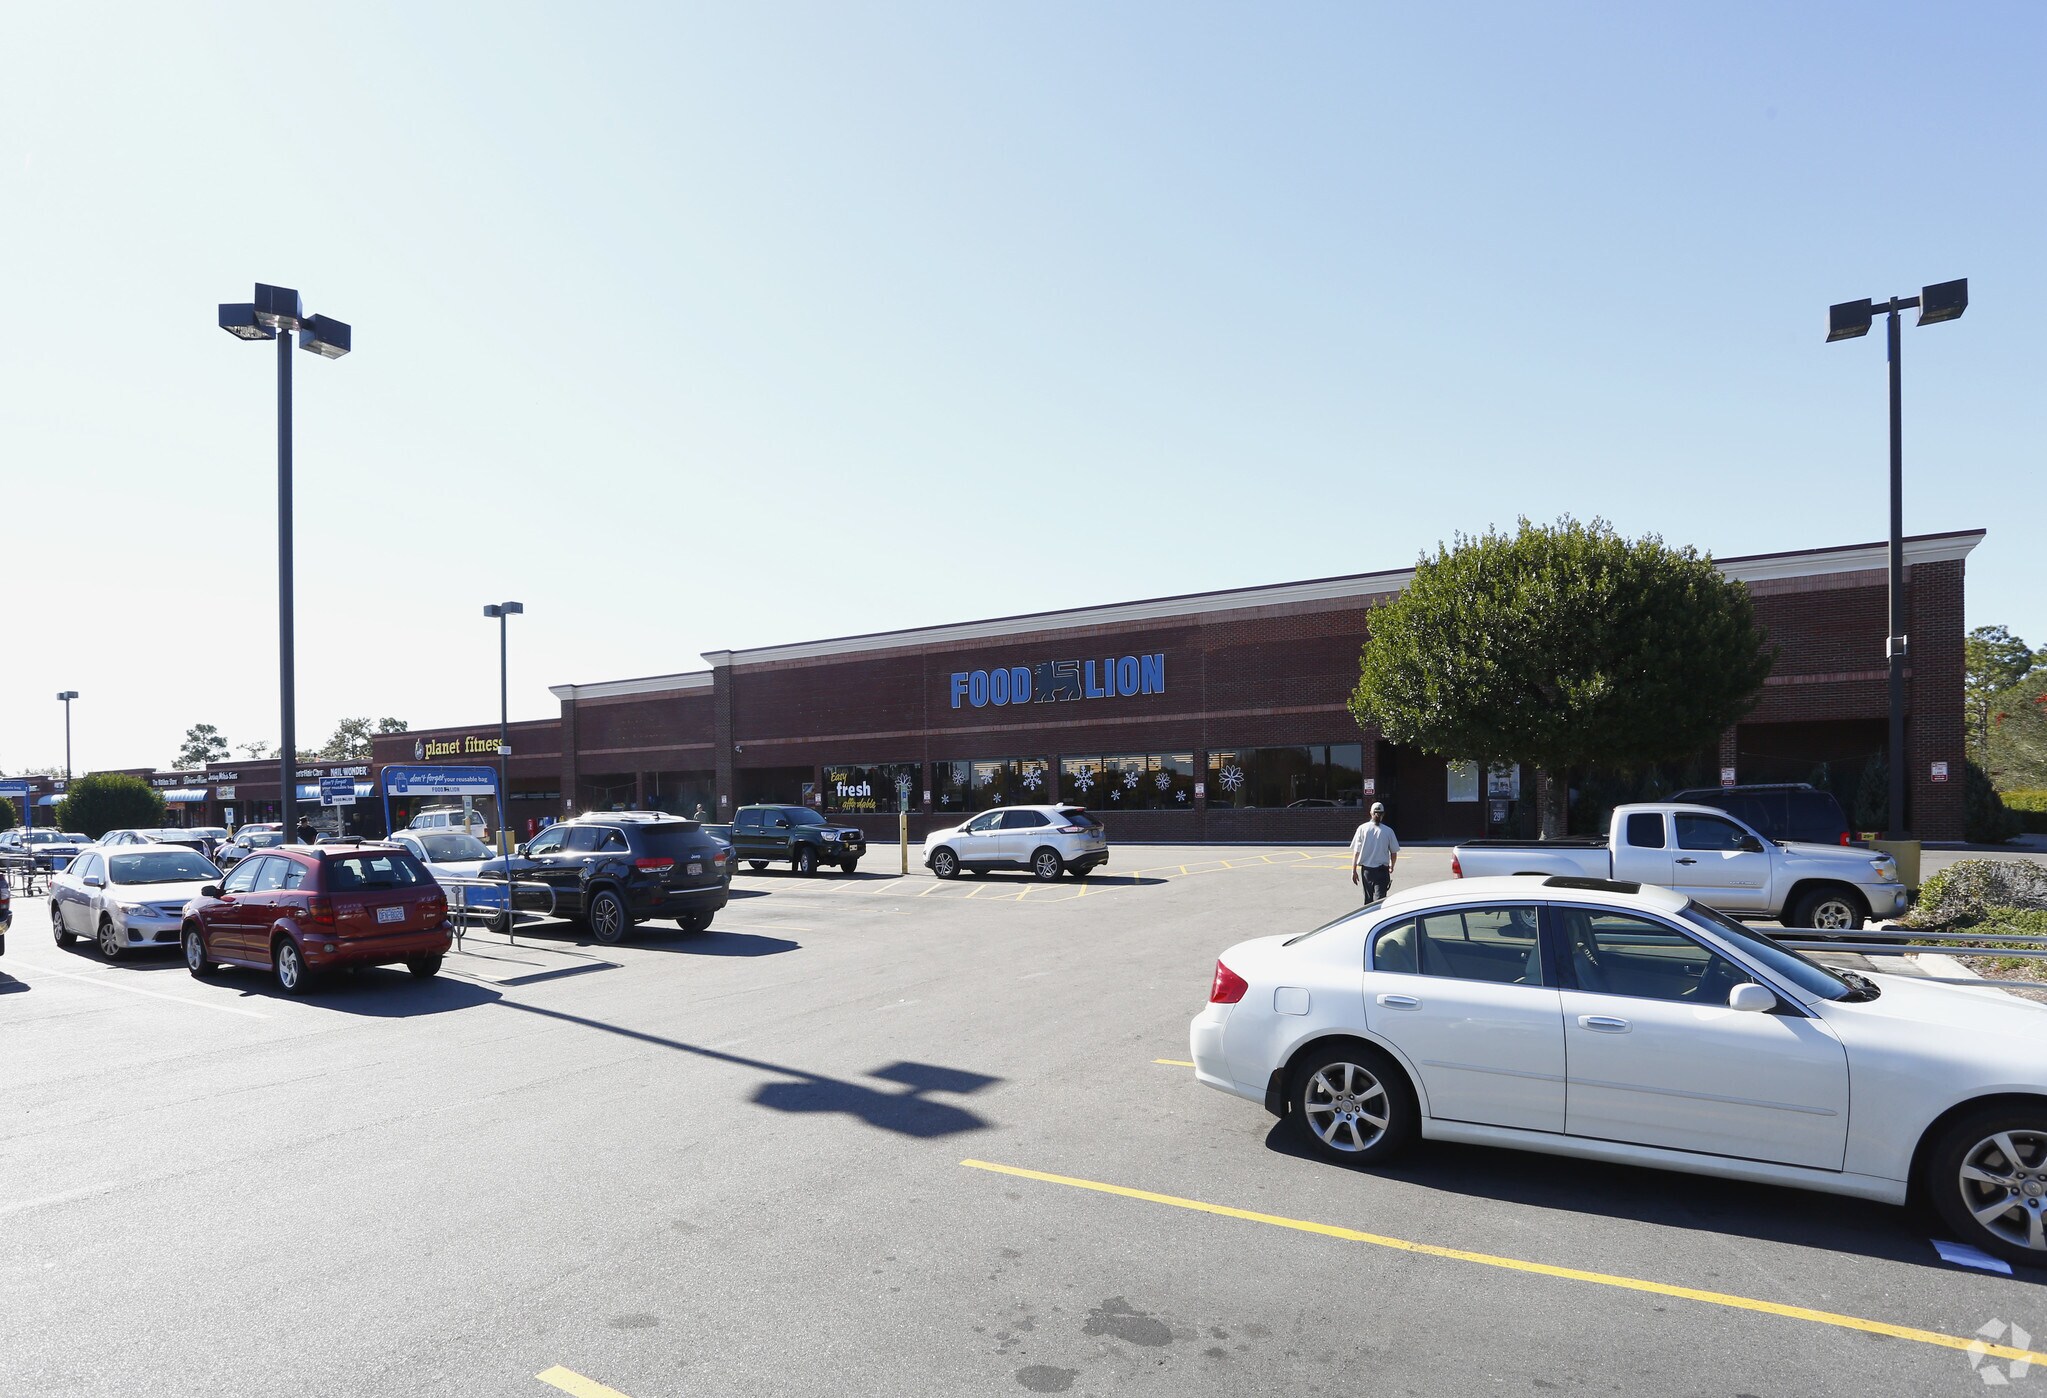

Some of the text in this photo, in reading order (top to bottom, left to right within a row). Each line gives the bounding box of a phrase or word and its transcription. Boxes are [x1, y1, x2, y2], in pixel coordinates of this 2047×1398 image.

[950, 653, 1165, 709] FOOD LION
[425, 739, 460, 760] planet
[343, 766, 368, 776] WONDER
[830, 771, 848, 785] Easy
[409, 774, 426, 783] don't
[426, 773, 445, 785] forget
[444, 776, 455, 784] your
[478, 776, 488, 784] bag
[836, 780, 871, 797] fresh
